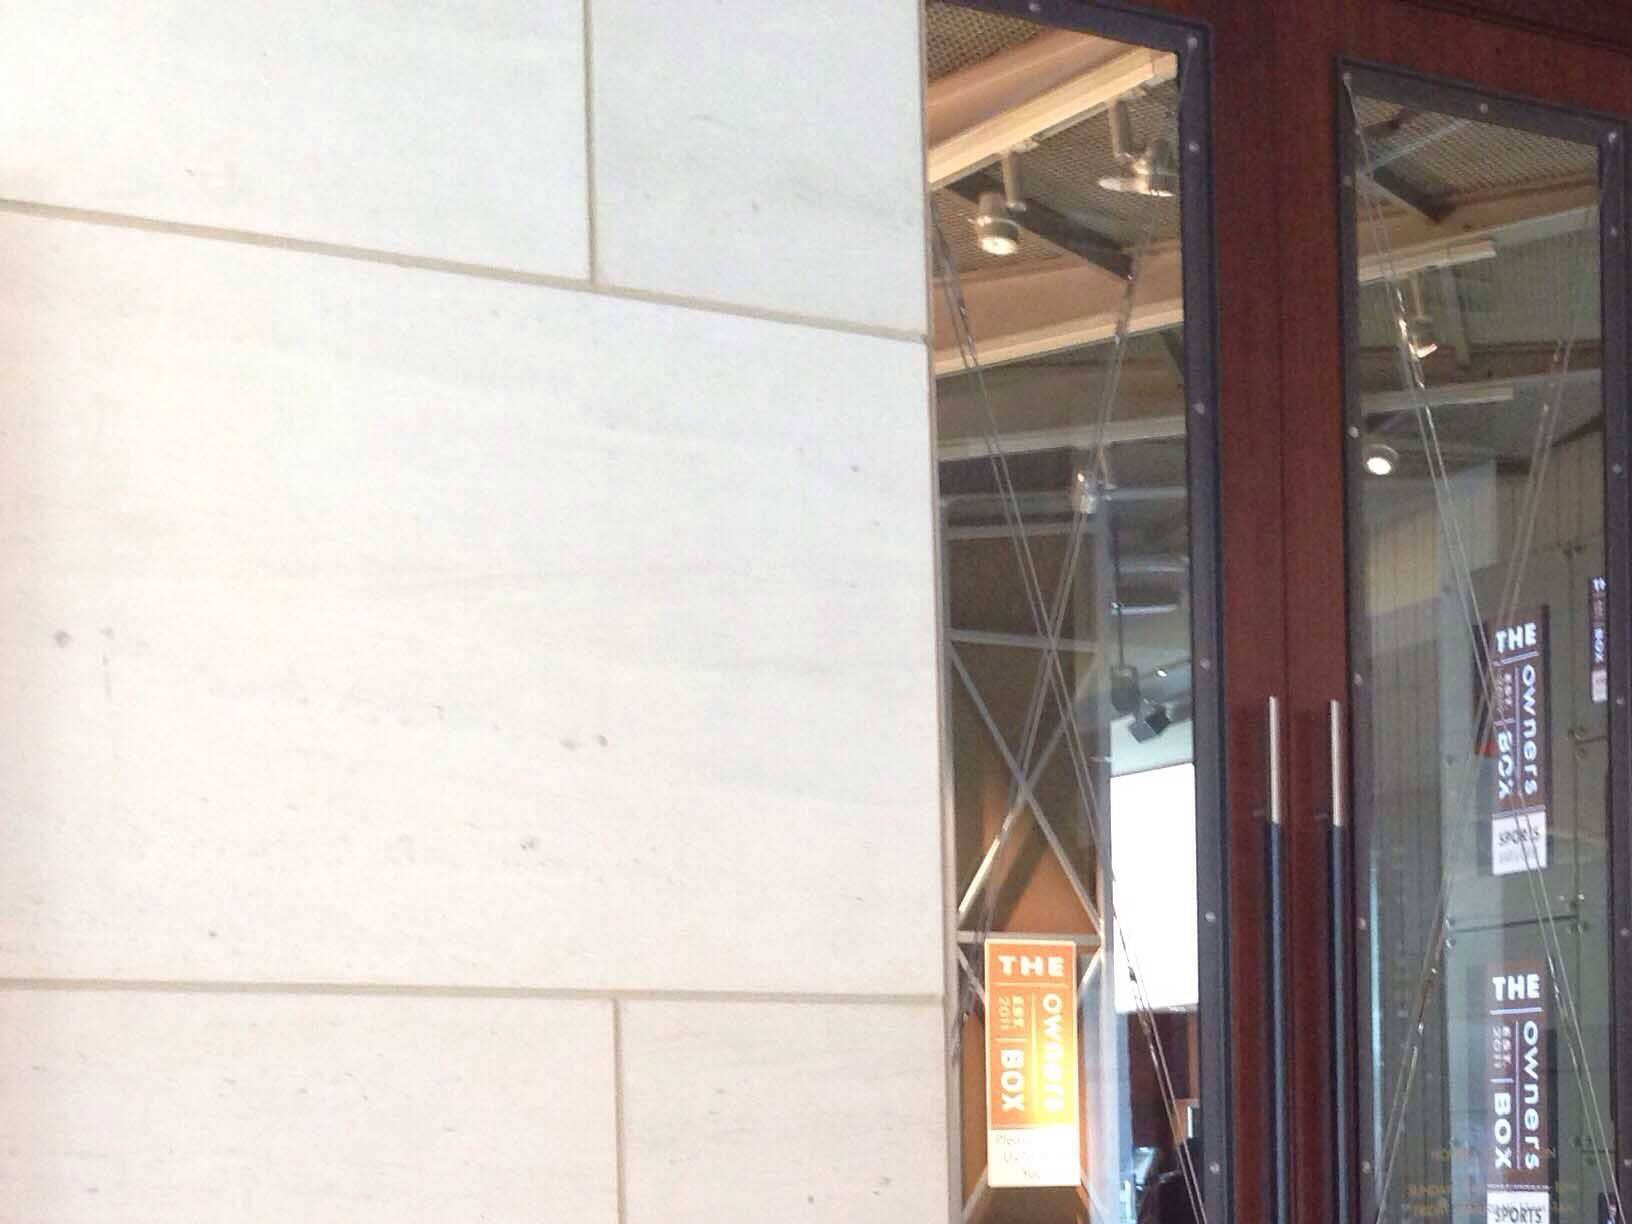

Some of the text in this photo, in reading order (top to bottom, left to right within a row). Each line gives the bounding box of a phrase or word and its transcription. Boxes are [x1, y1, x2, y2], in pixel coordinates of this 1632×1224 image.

[1496, 623, 1537, 653] THE
[1522, 664, 1539, 796] owners
[1497, 731, 1514, 799] BOX
[998, 955, 1064, 977] THE
[1492, 974, 1540, 1001] THE
[1000, 1049, 1025, 1112] BOX
[1523, 1020, 1540, 1170] owners
[1494, 1093, 1512, 1169] BOX
[1495, 1206, 1543, 1224] SPORTS
